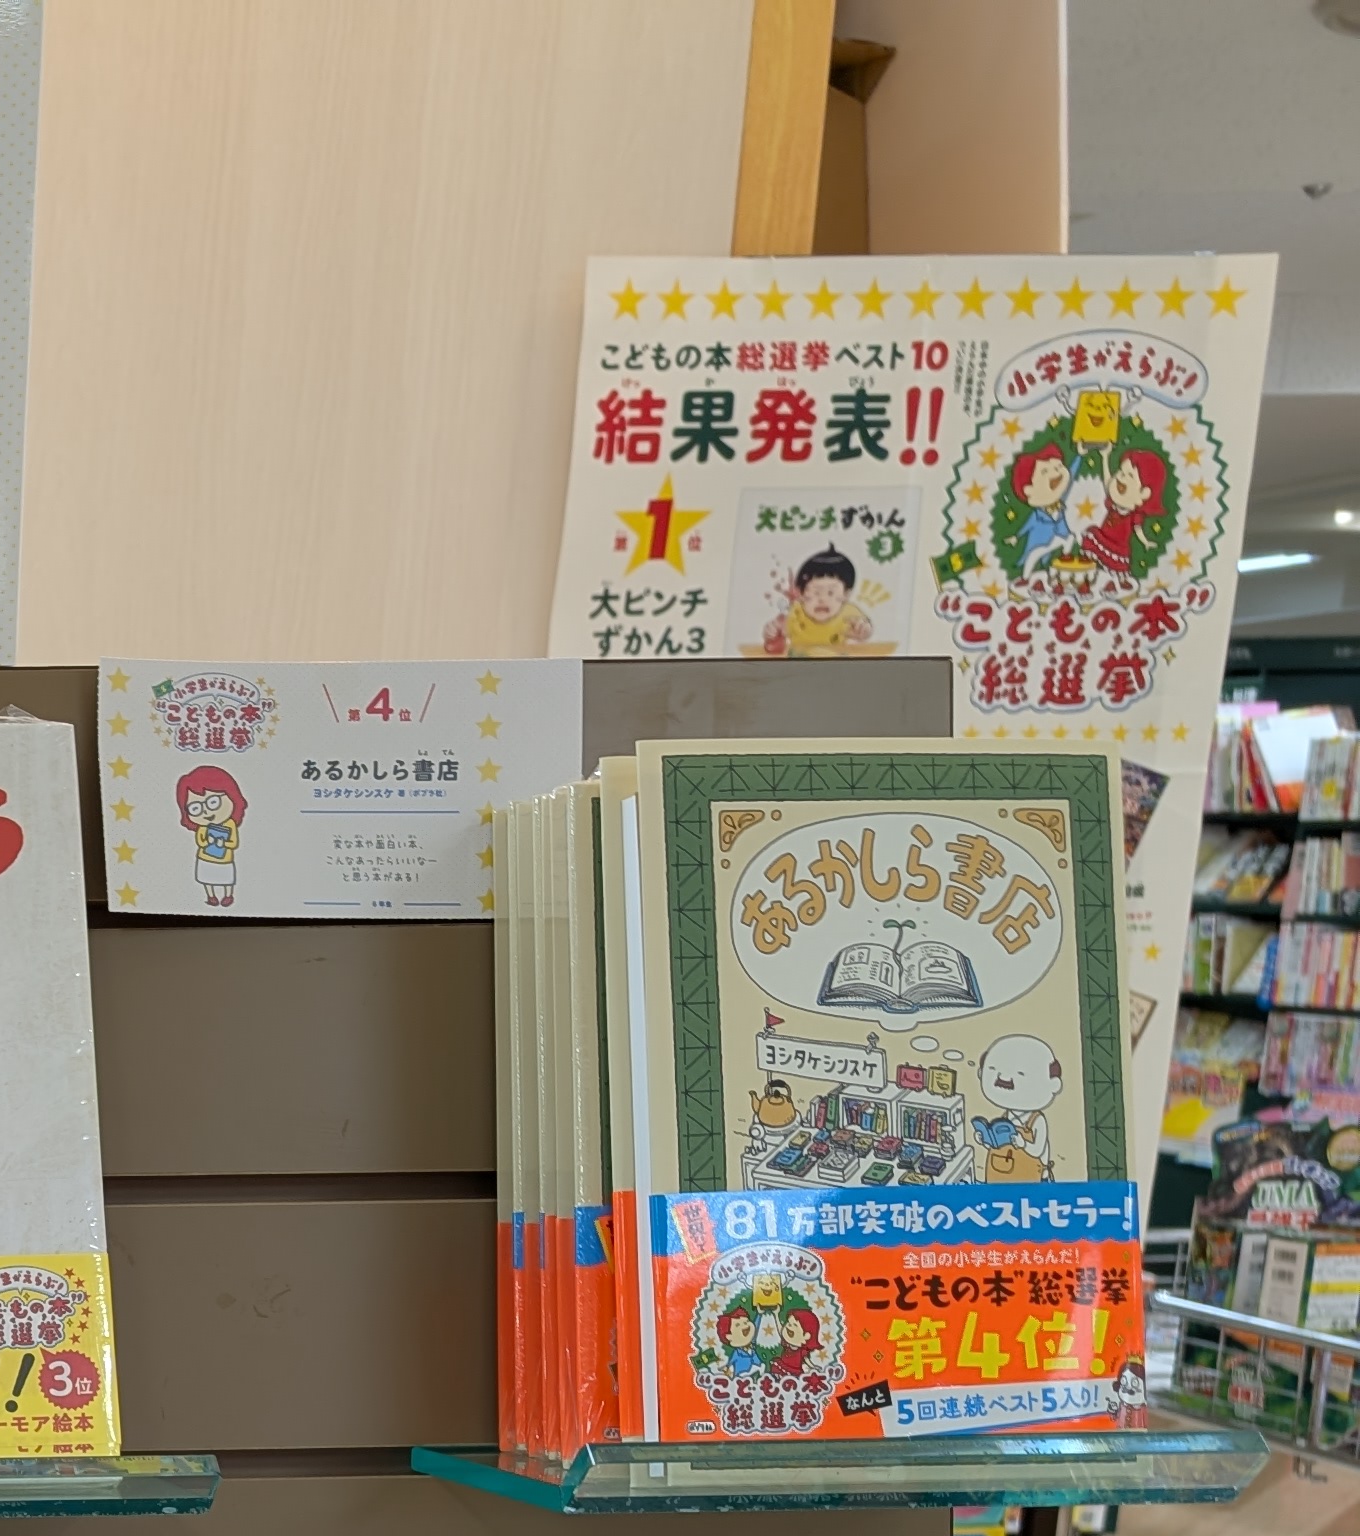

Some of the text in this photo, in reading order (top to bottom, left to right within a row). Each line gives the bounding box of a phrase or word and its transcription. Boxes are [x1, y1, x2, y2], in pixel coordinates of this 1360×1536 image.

[600, 340, 950, 371] こどもの本総選挙ベスト10
[1007, 340, 1201, 399] 小学生がえらぶ!
[593, 386, 945, 467] 結果発表!!
[588, 589, 709, 622] 大ピンチ
[592, 625, 707, 657] ずかん3
[977, 652, 1150, 705] 総選挙
[347, 687, 412, 722] 第4位
[300, 759, 460, 782] あるかしら書店
[739, 824, 1057, 955] あるかしら書店
[764, 1046, 879, 1079] ヨシタケシンスケ
[724, 1196, 1133, 1240] 81万部突破のベストセラー!
[903, 1248, 1081, 1270] 全国の小学生がえらんだ!
[887, 1311, 1108, 1381] 第4位!
[47, 1360, 94, 1397] 3位
[845, 1390, 887, 1411] なんと
[897, 1385, 1099, 1424] 5回連続ベスト5入り!
